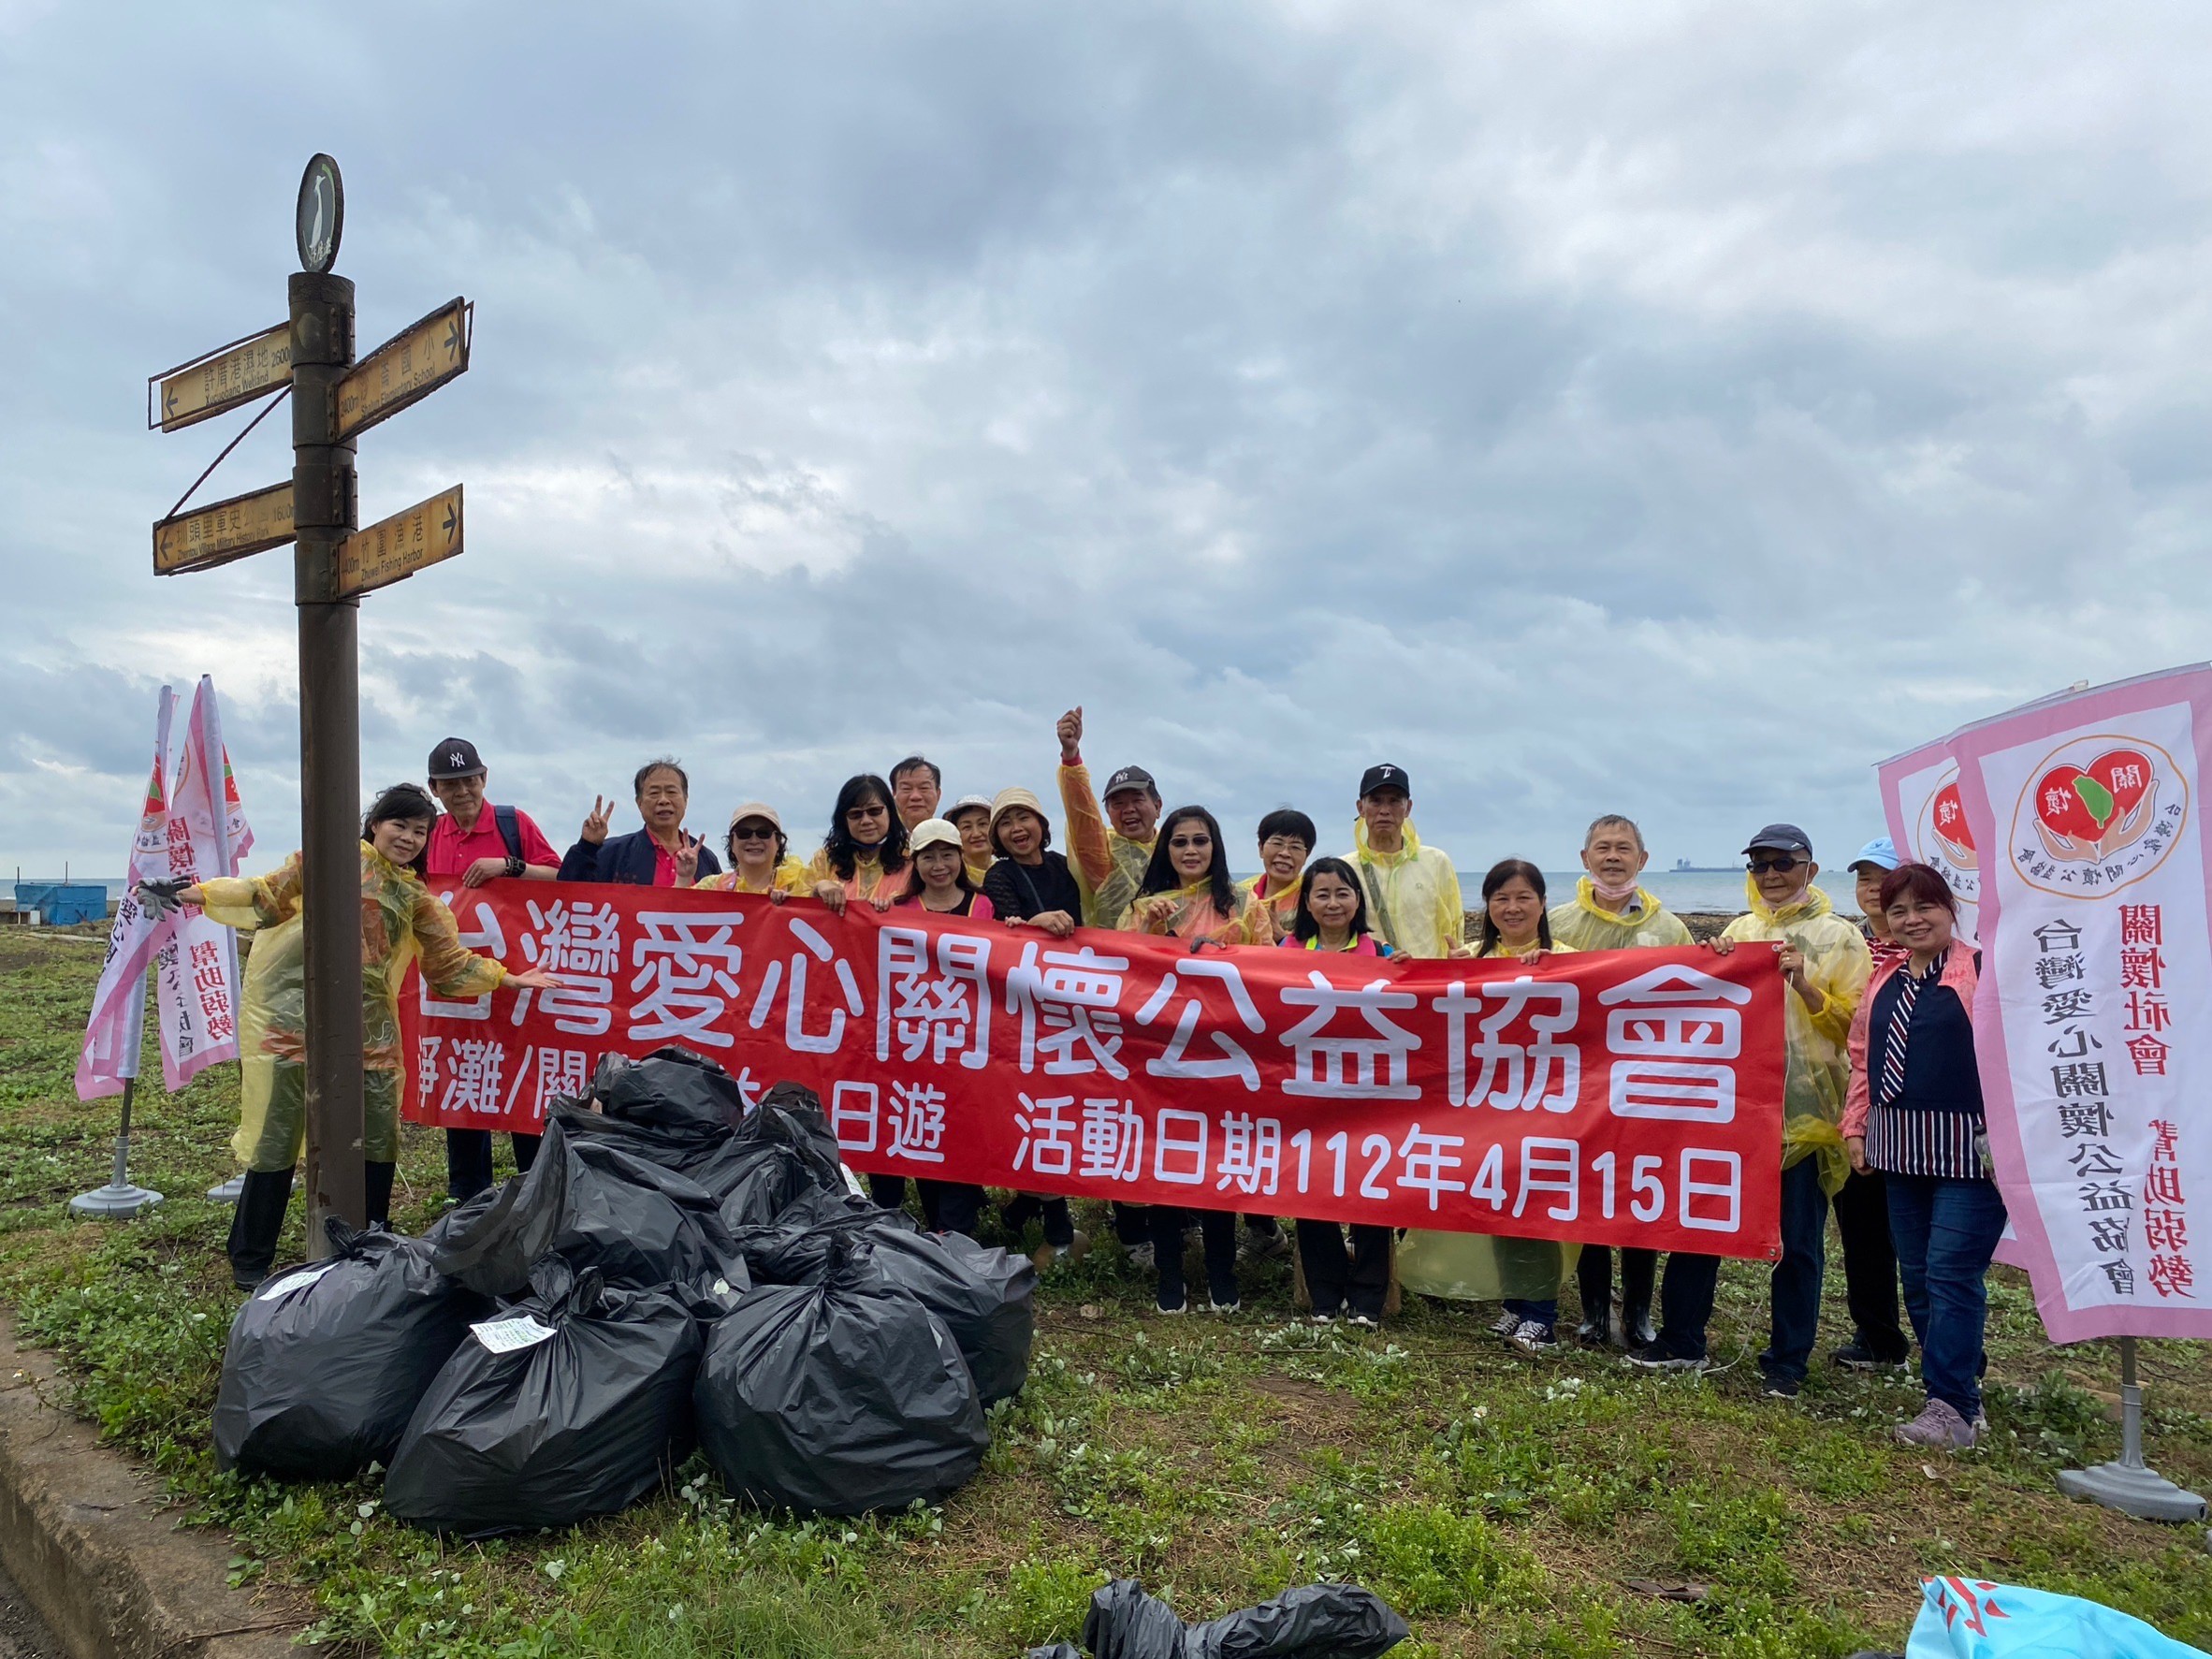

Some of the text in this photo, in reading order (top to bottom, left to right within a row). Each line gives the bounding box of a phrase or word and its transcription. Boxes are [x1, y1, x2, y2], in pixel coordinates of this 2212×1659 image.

[271, 346, 291, 368] 2600
[242, 371, 269, 390] Wetland
[415, 361, 436, 386] School
[198, 541, 216, 555] Village
[217, 537, 235, 549] Military
[236, 531, 255, 545] History
[256, 527, 269, 539] Park
[381, 556, 402, 574] Fishing
[402, 548, 424, 565] Harbor
[450, 752, 466, 767] NY
[419, 890, 1752, 1125] 台灣愛心關懷公益協會
[1012, 1092, 1742, 1233] 活動日期112年4月15日
